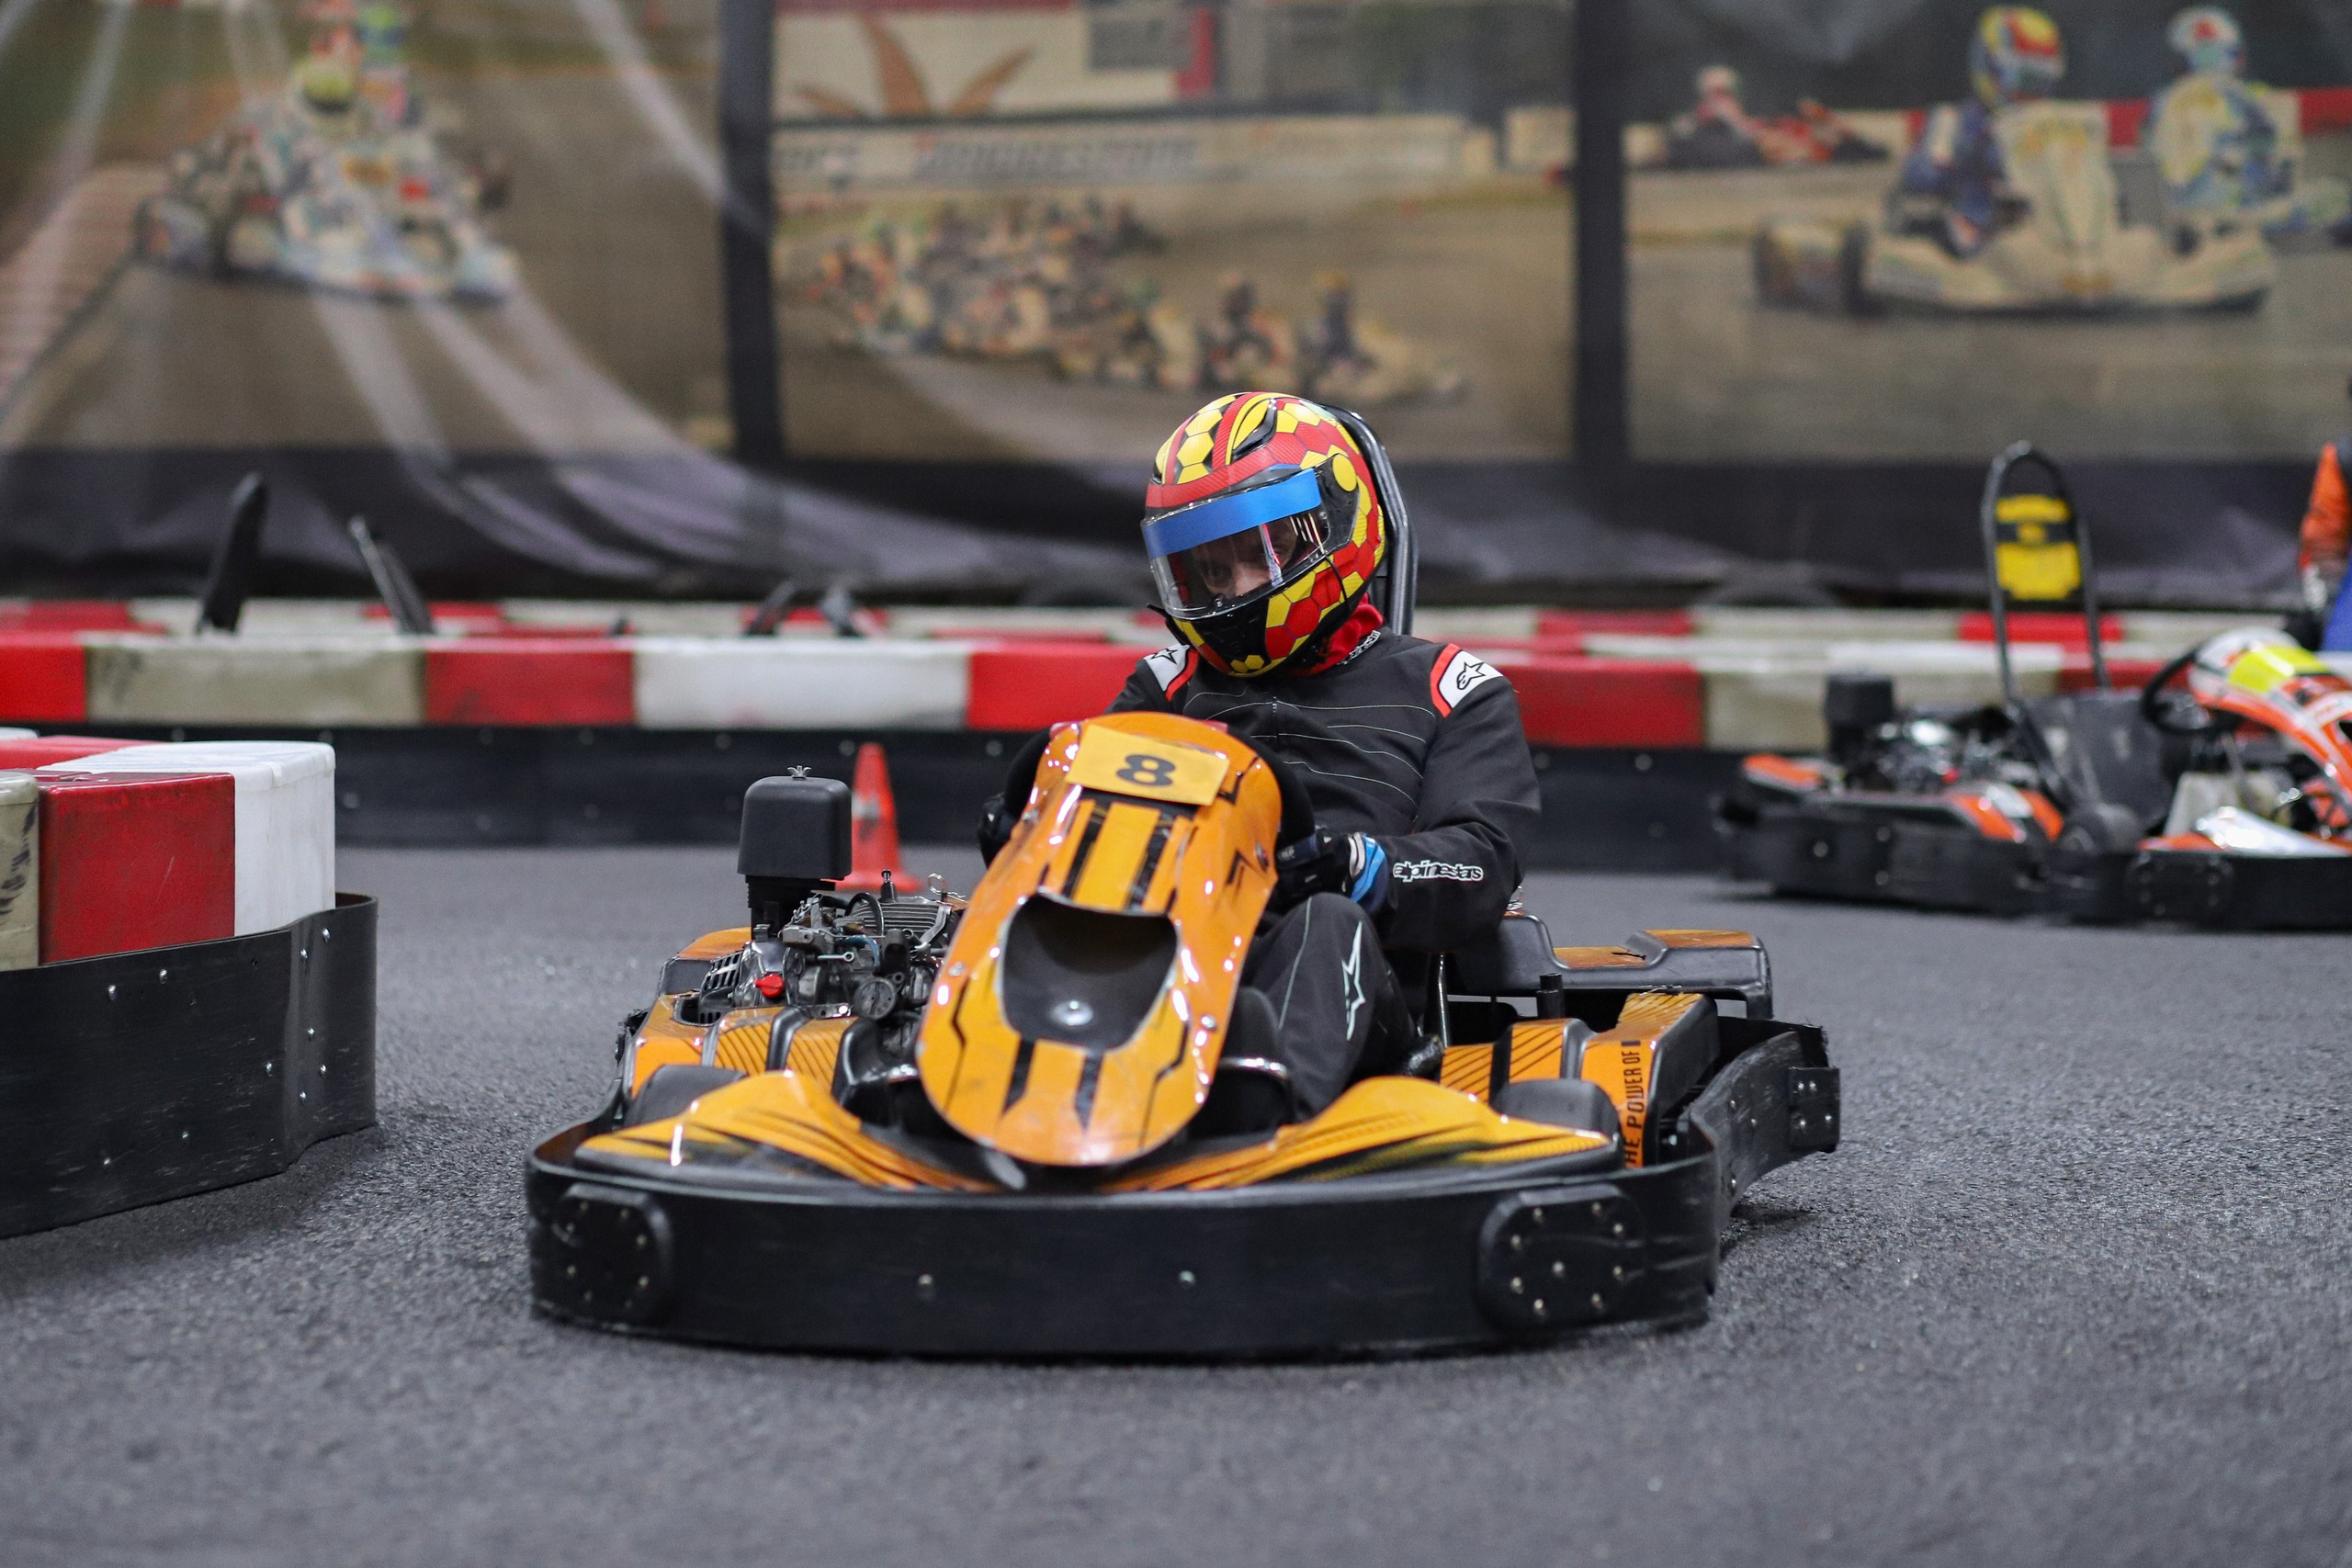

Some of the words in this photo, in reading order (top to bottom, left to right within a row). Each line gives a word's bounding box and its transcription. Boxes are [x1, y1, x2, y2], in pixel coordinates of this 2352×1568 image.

[1116, 754, 1176, 787] 8
[1621, 1051, 1641, 1065] OF
[1623, 1067, 1645, 1130] POWER
[1624, 1137, 1640, 1164] HE
